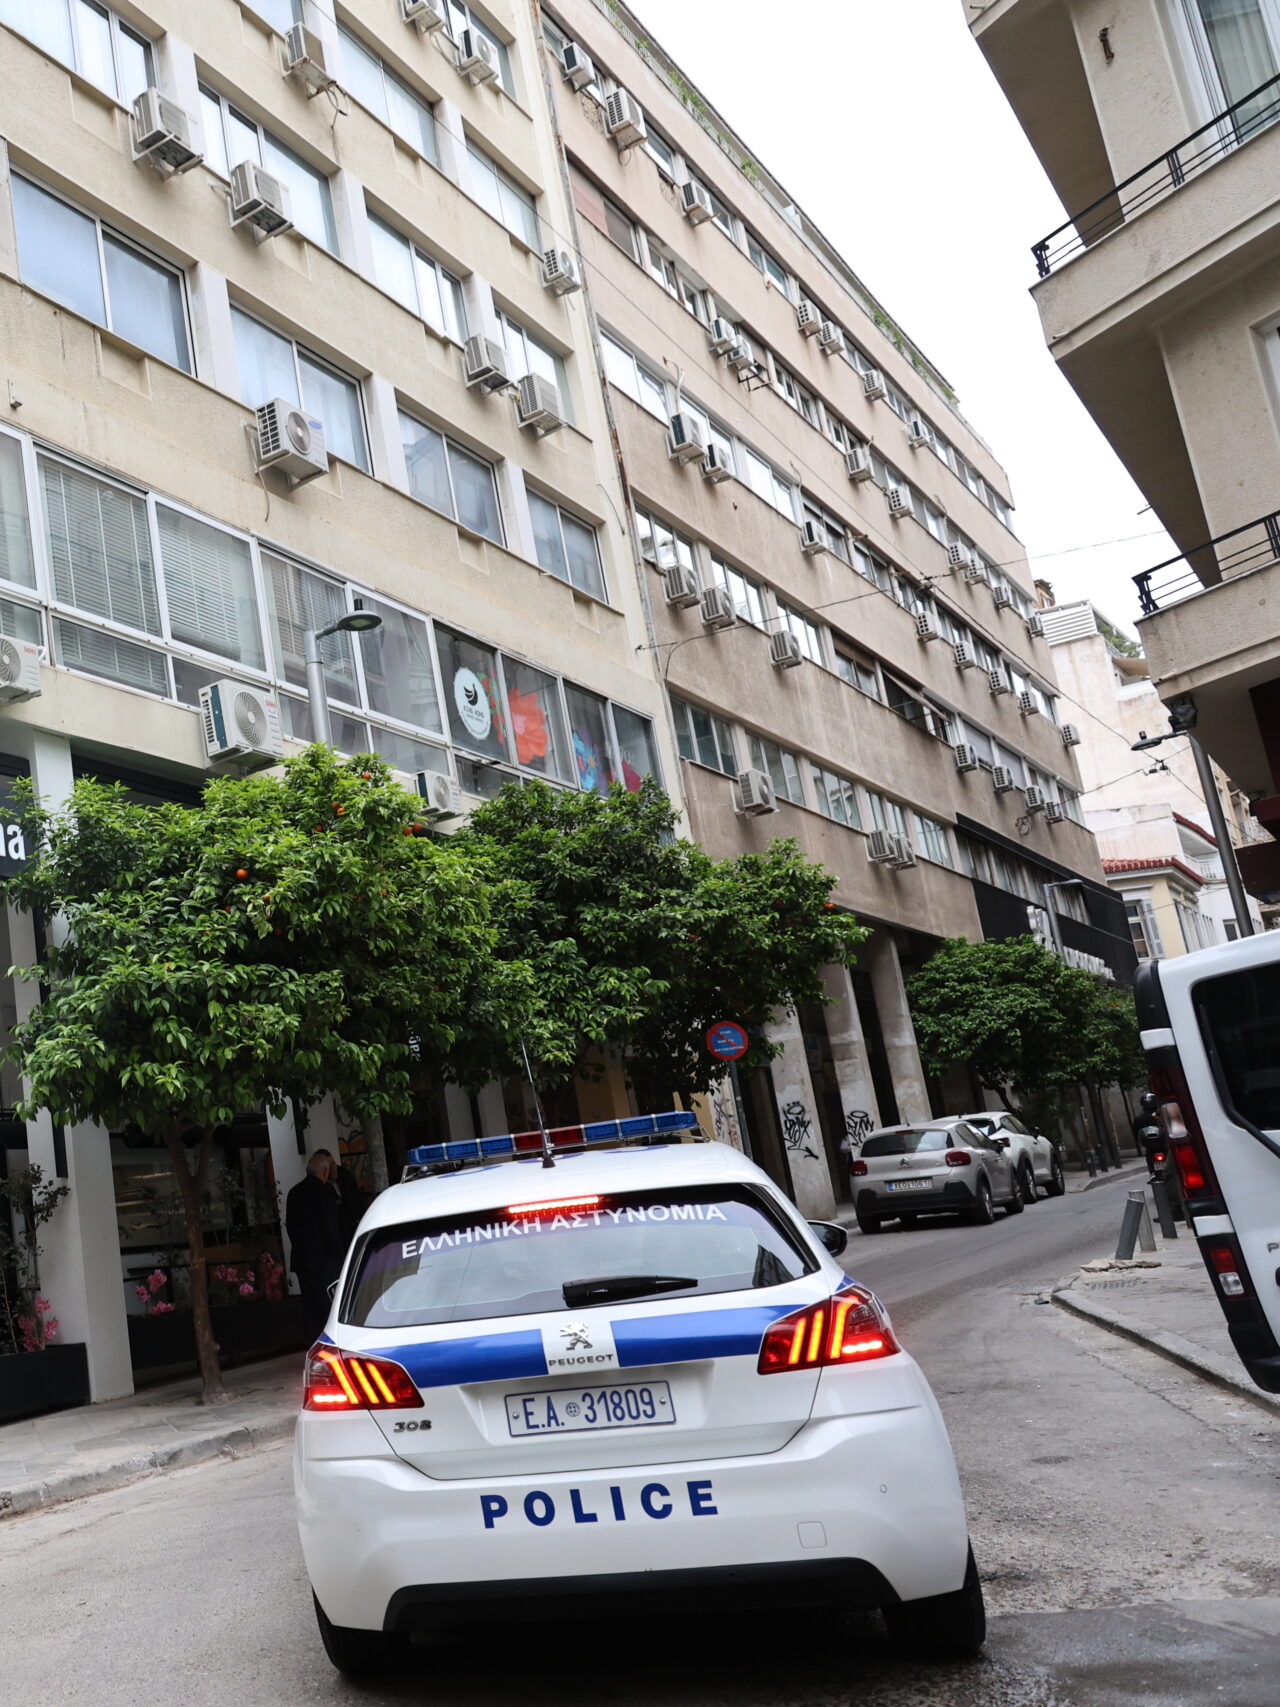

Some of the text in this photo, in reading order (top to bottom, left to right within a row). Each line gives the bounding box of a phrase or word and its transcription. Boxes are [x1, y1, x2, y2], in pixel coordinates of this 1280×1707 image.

[401, 1203, 728, 1260] ΕΛΛΗΝΙΚΗ ΑΣΤΥΝΟΜΙΑ
[548, 1353, 614, 1367] PEUGEOT
[581, 1387, 657, 1423] 31809
[393, 1419, 432, 1434] 308
[479, 1479, 719, 1529] POLICE
